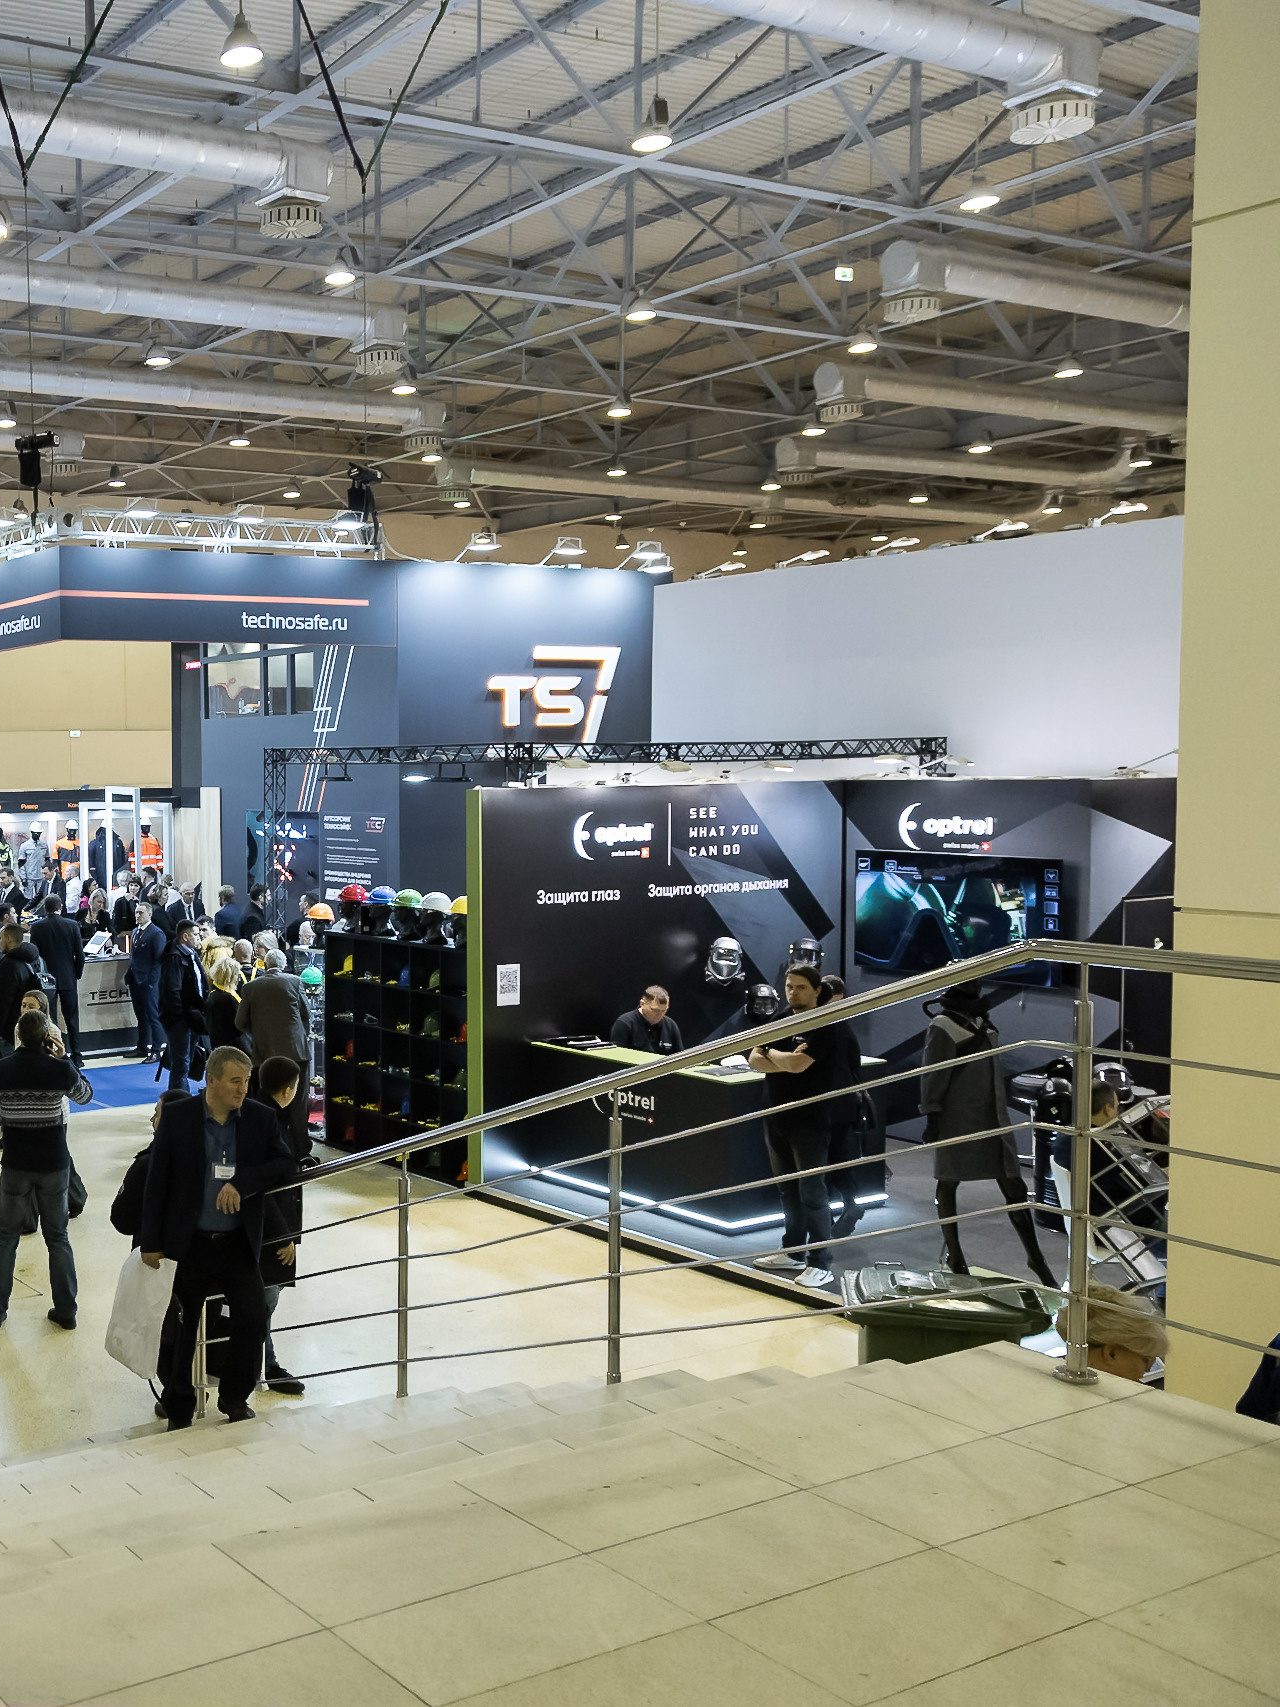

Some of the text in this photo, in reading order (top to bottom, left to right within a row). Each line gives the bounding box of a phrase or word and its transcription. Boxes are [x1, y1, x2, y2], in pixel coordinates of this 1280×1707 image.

[241, 612, 348, 631] technosafe.ru
[690, 807, 717, 819] SEE
[595, 823, 653, 846] optrel
[689, 824, 759, 838] WHAT YOU
[923, 816, 993, 837] optrel
[689, 844, 741, 857] CAN DO
[537, 888, 621, 904] Защита глаз
[648, 879, 789, 898] Защита органов дыхания
